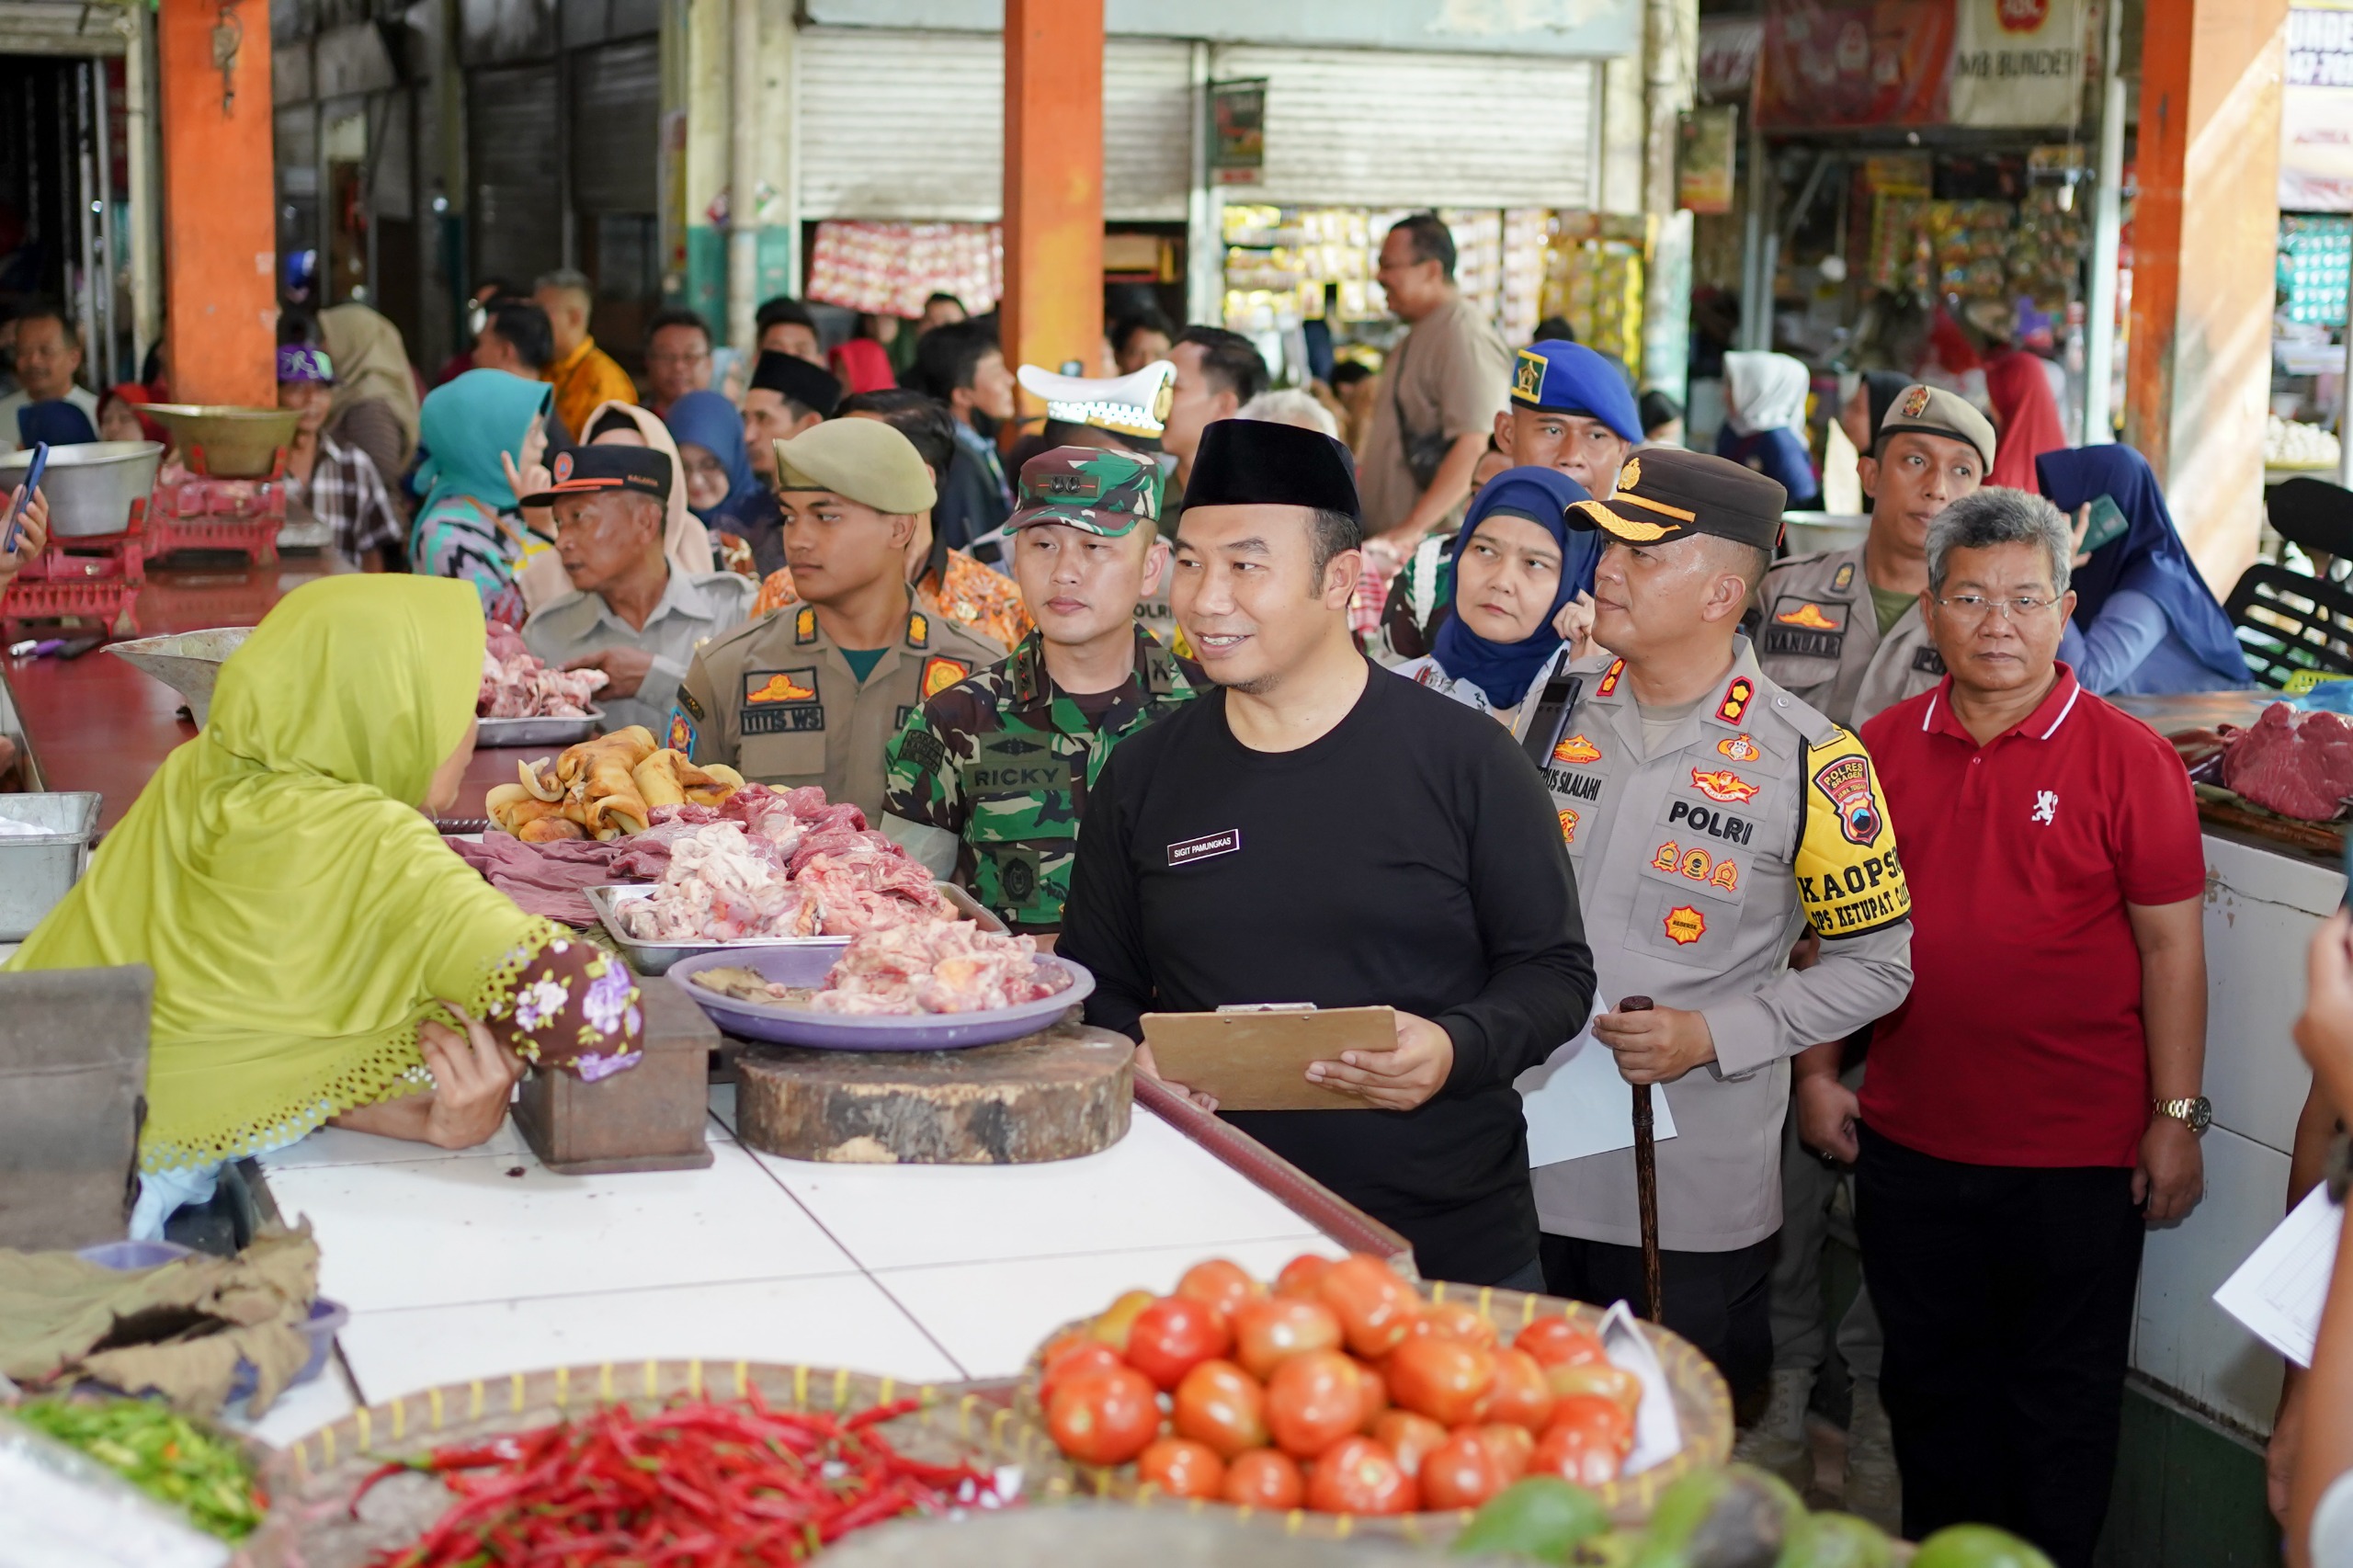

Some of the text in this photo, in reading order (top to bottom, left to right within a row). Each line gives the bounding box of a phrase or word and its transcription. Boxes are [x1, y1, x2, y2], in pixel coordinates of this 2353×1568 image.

[1132, 602, 1173, 619] OLRI
[974, 767, 1059, 787] RICKY
[1824, 762, 1863, 786] POLRES
[1831, 772, 1863, 789] SRAGEN
[1557, 771, 1602, 801] SILALAHI
[1668, 801, 1754, 846] POLRI
[1174, 837, 1232, 858] SIGIT PAMUNGKAS
[1835, 891, 1894, 927] KETUPAT
